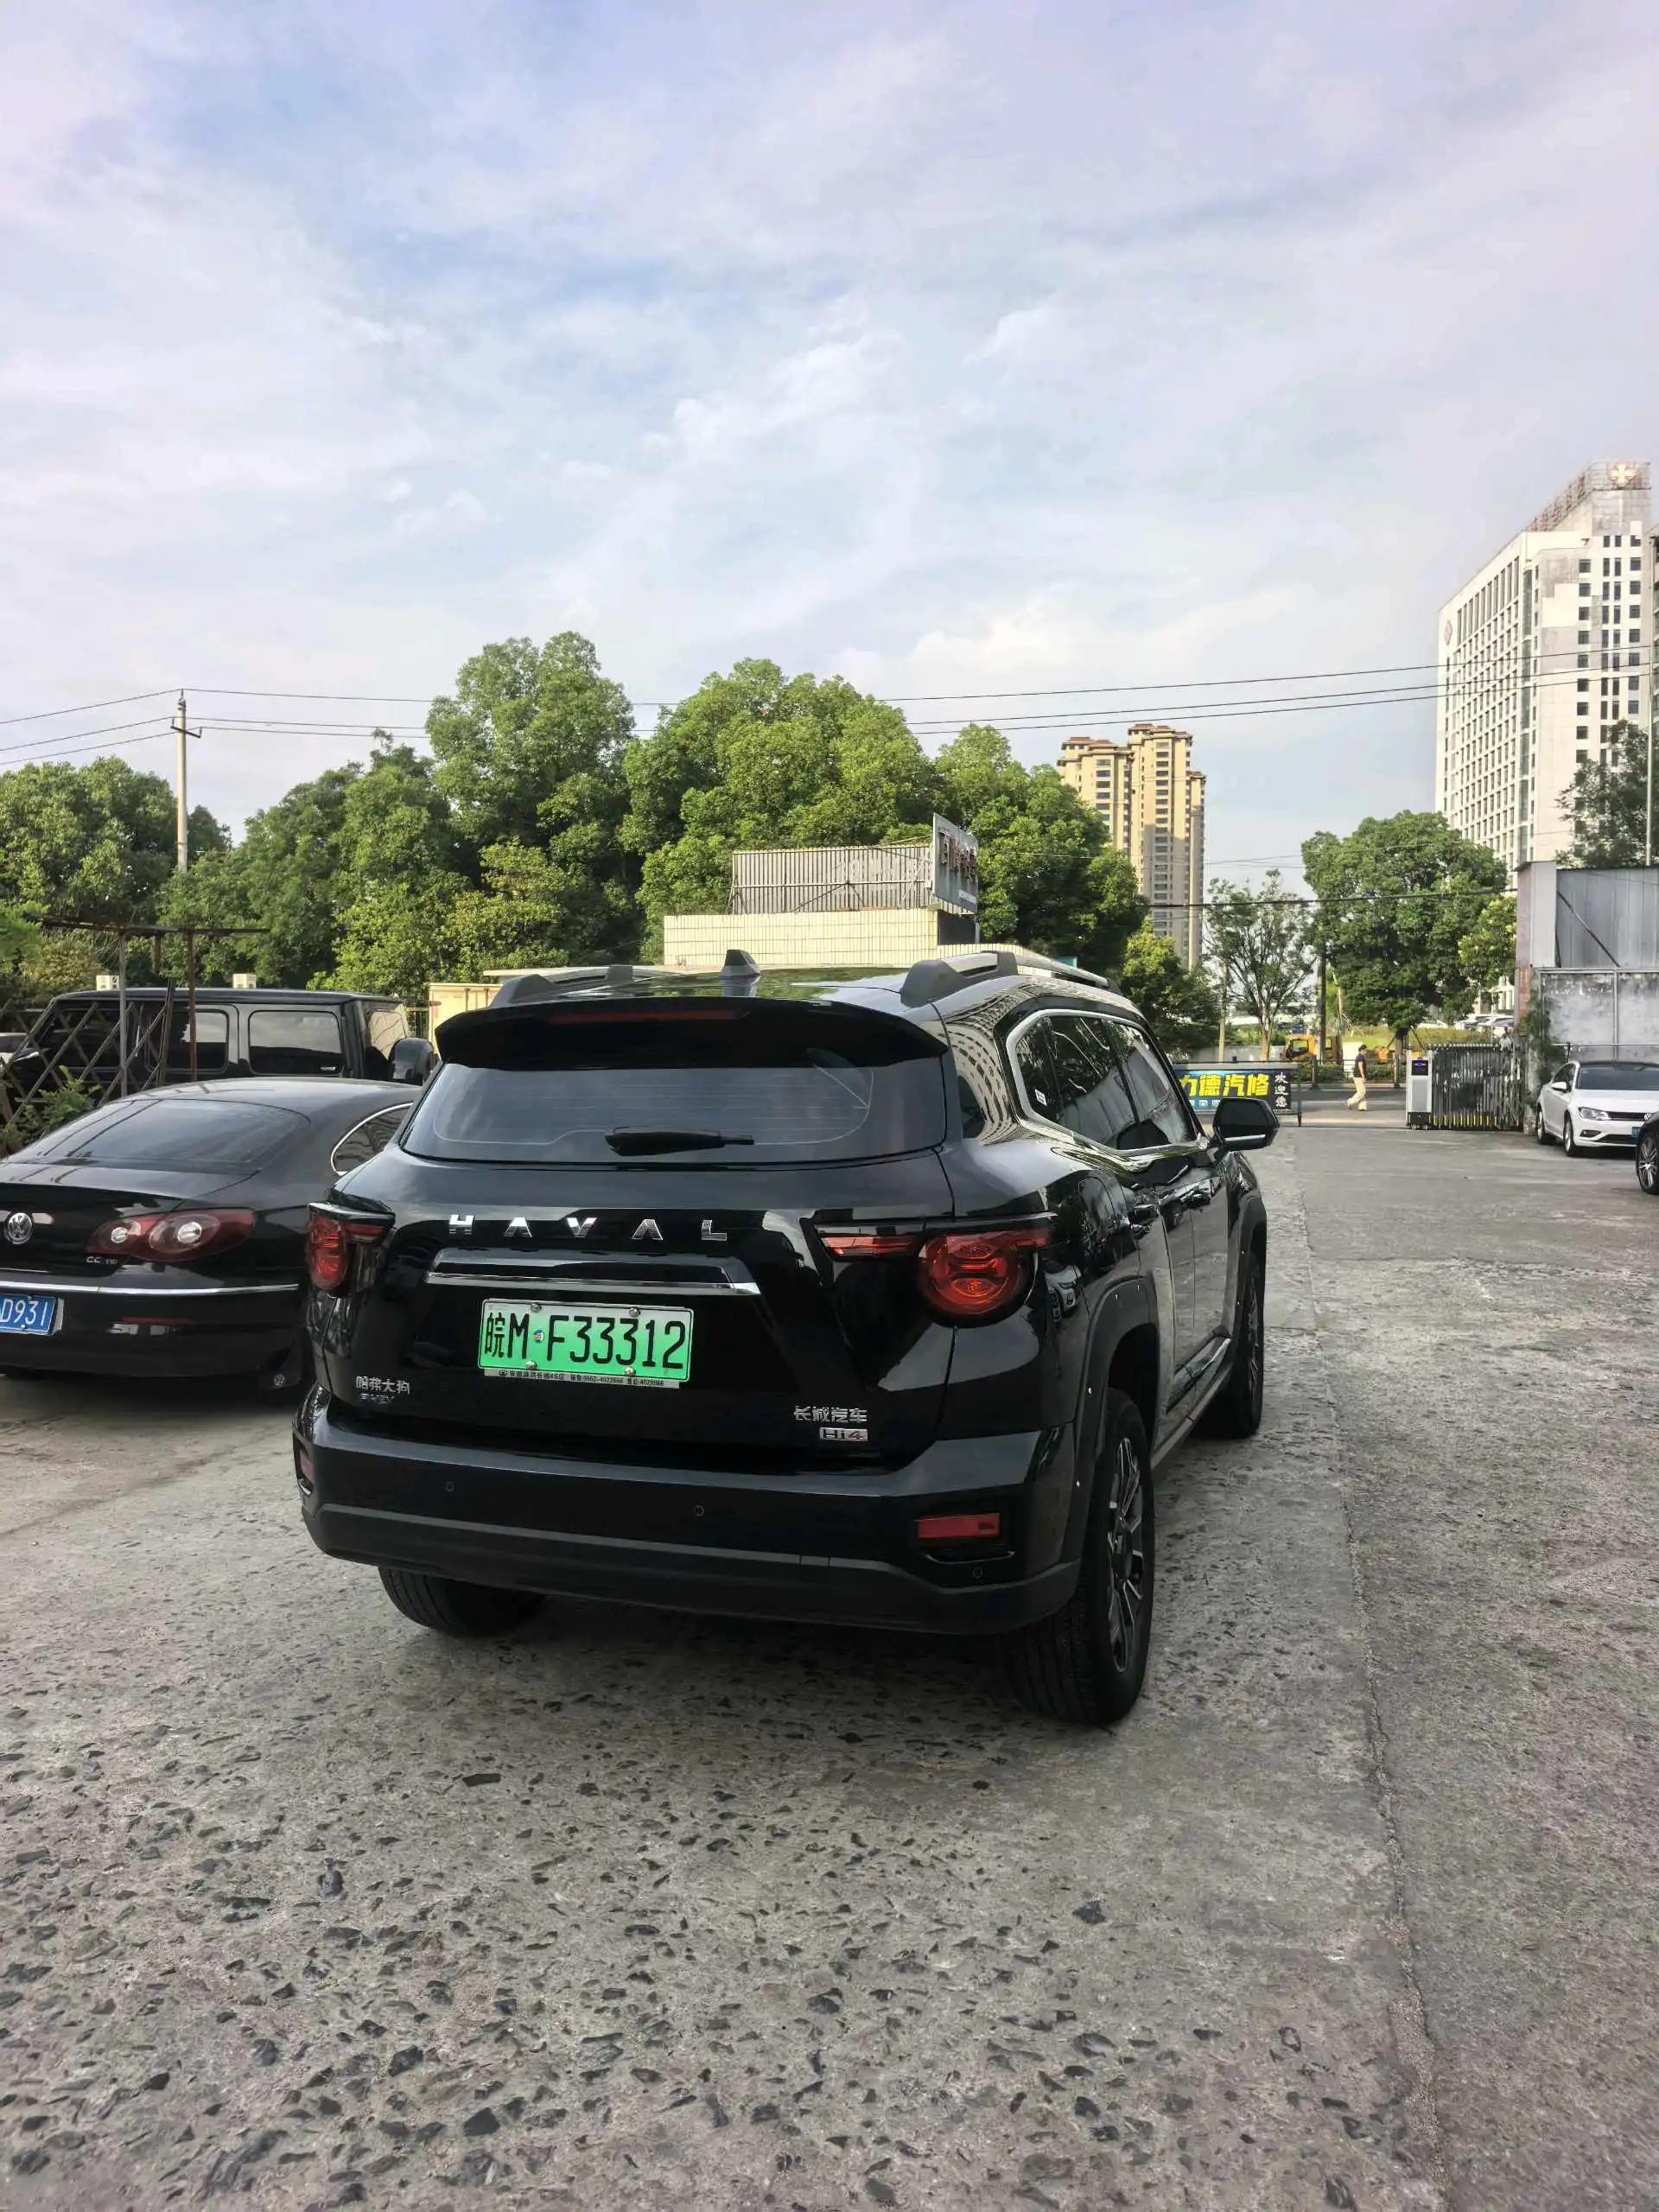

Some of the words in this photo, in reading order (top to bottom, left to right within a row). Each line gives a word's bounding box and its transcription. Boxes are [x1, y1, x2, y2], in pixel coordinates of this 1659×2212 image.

[1274, 1071, 1288, 1108] 欢迎您
[448, 1214, 728, 1242] HAVAL
[0, 1299, 48, 1326] D931
[355, 1376, 410, 1395] 哈弗大狗
[794, 1406, 868, 1422] 长城汽车
